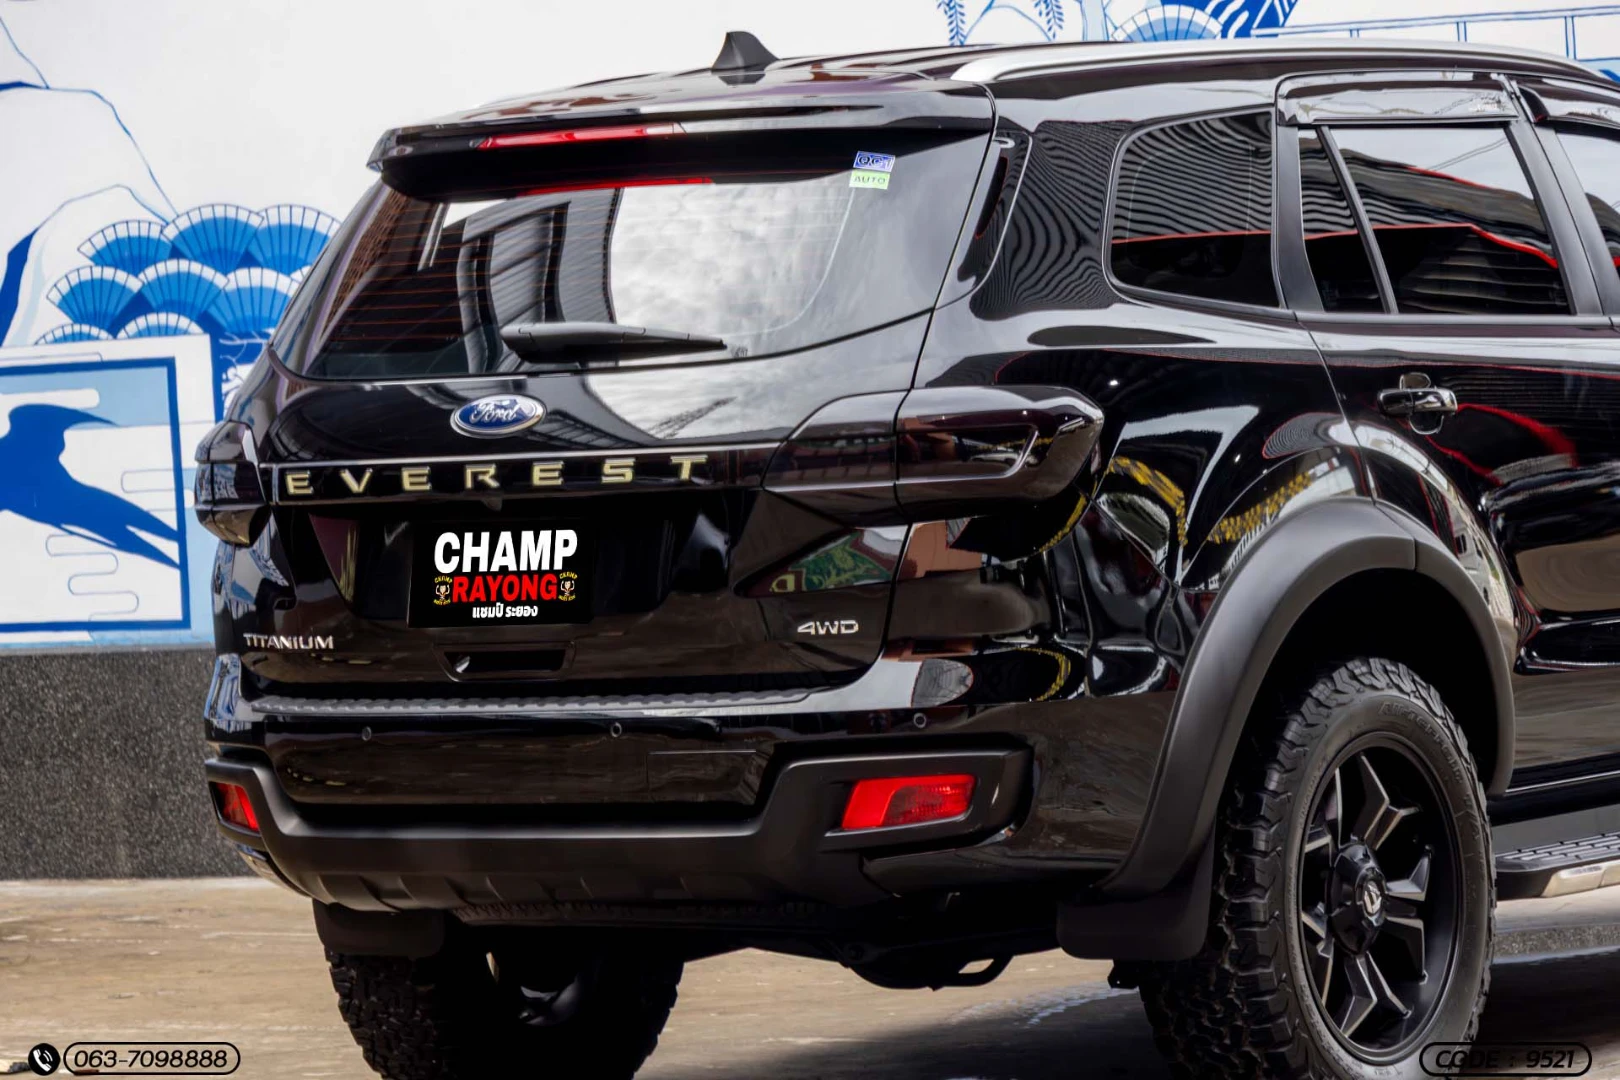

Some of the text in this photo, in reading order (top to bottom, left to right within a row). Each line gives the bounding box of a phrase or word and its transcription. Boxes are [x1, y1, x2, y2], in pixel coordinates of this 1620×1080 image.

[854, 176, 886, 185] AUTO
[469, 402, 520, 424] Ford
[285, 455, 709, 496] EVEREST
[434, 529, 578, 574] CHAMP
[452, 573, 558, 603] RAYONG
[505, 605, 539, 618] ระยอง
[797, 619, 859, 635] 4WD
[243, 632, 334, 649] TITANIUM
